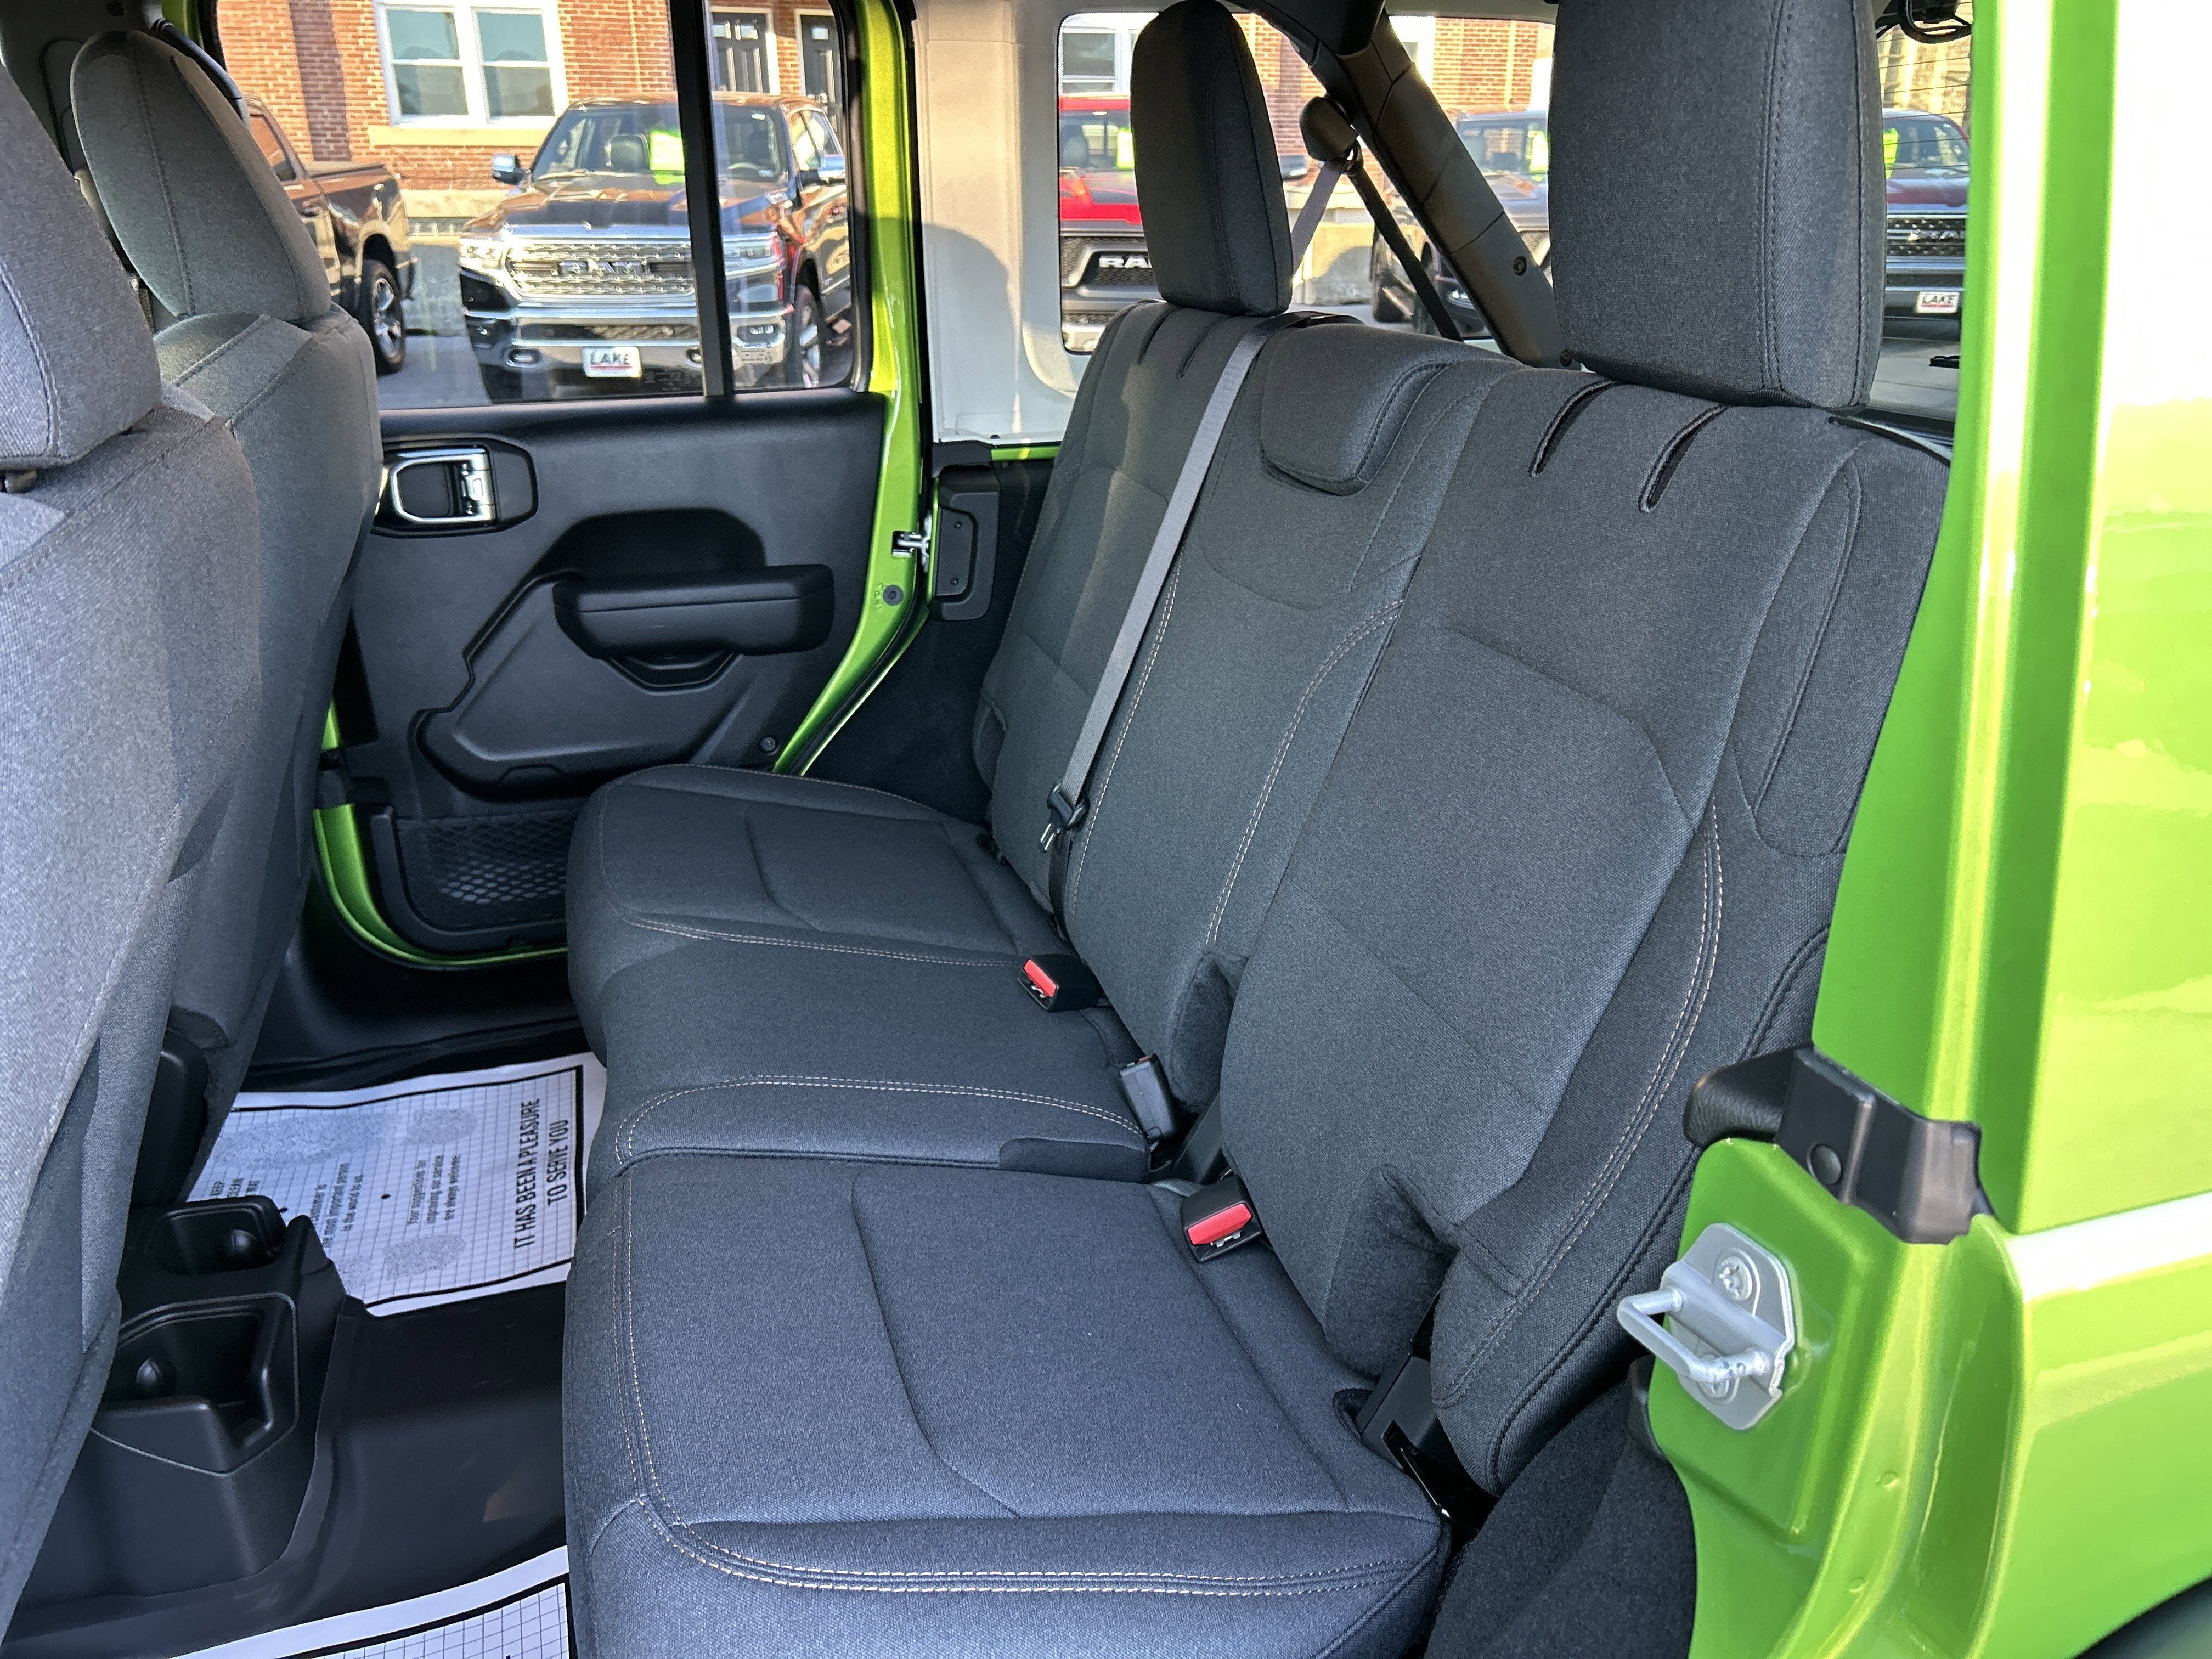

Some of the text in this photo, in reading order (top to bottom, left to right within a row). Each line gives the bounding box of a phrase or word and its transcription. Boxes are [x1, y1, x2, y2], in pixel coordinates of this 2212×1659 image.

[1099, 255, 1152, 268] RA
[1922, 295, 1957, 303] LAKE
[590, 352, 629, 364] LAKE
[546, 1119, 569, 1206] TO SERVE YOU
[514, 1098, 540, 1249] IT HAS BEEN A PLEASURE
[411, 1170, 425, 1209] suggestions
[444, 1186, 459, 1207] always
[348, 1191, 360, 1210] world
[426, 1191, 442, 1224] improving
[342, 1211, 356, 1223] the
[405, 1209, 420, 1227] Your
